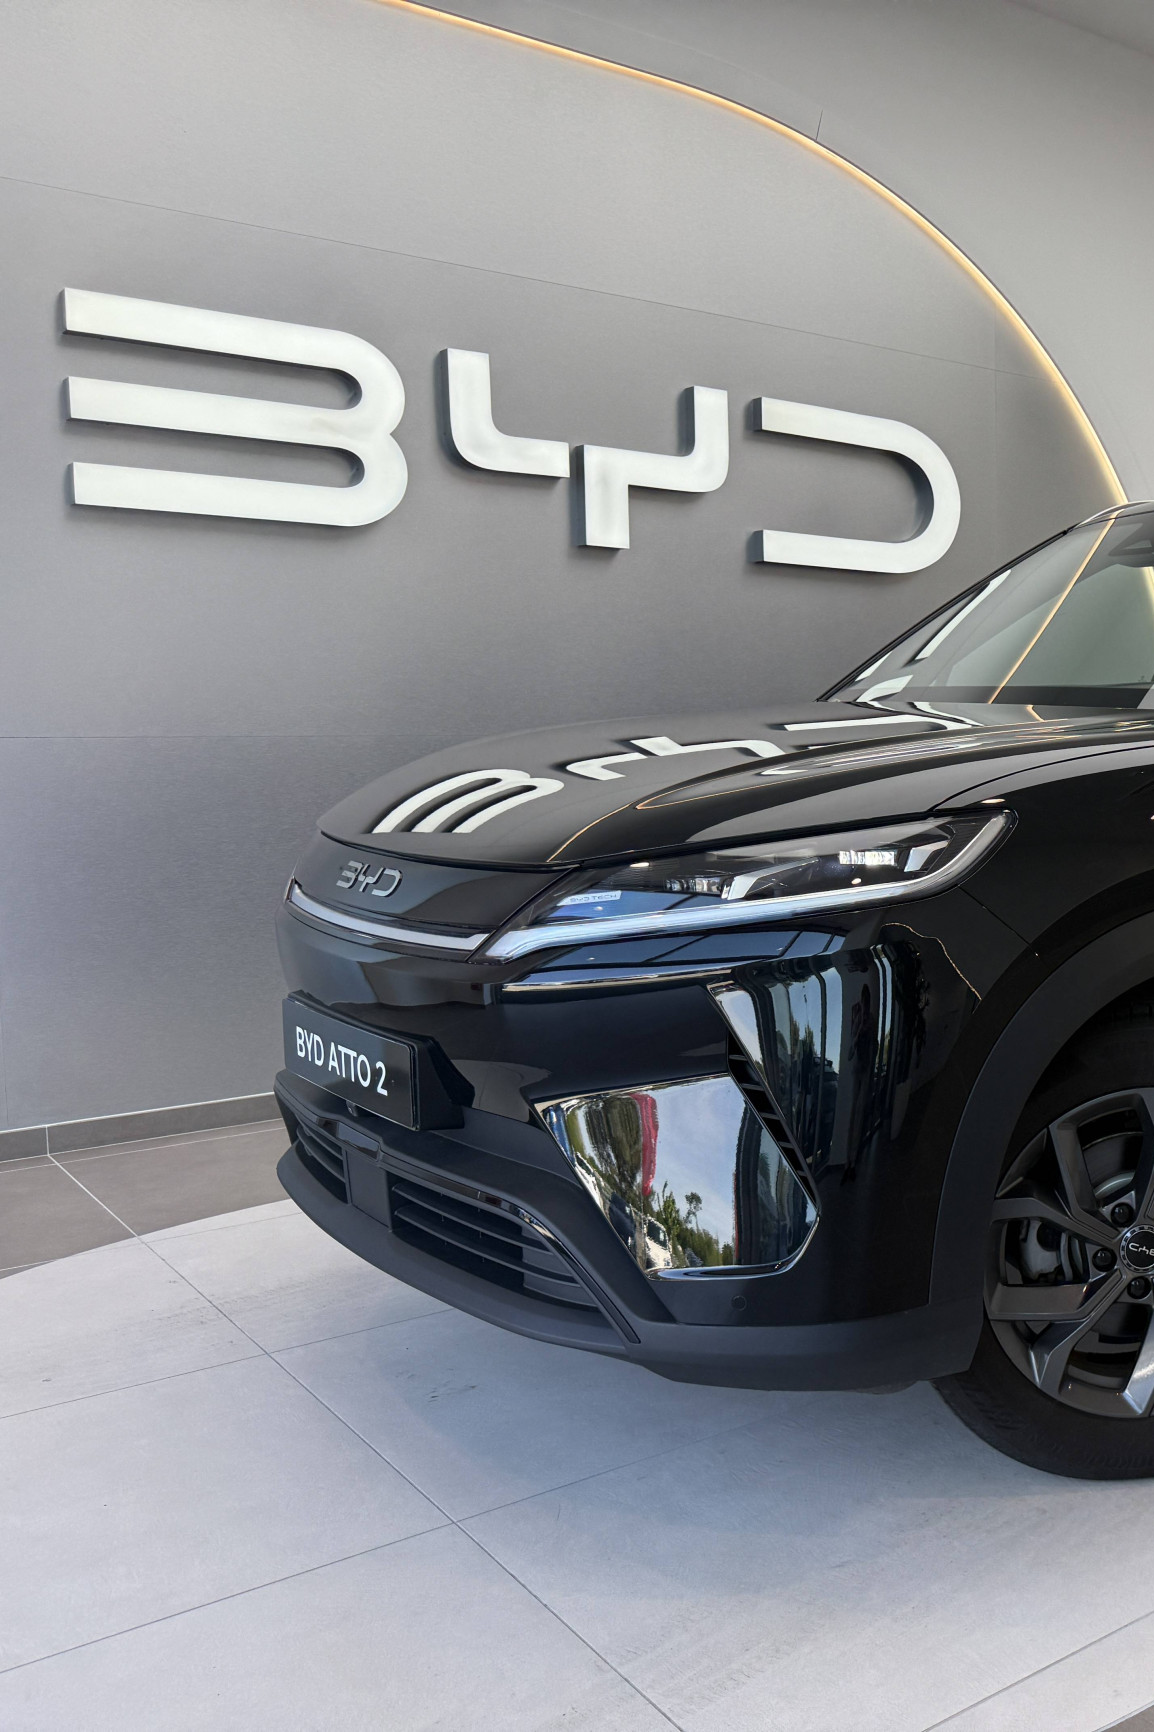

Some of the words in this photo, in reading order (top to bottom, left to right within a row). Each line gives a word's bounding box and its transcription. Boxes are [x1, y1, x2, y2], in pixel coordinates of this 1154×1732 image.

[62, 287, 961, 574] BYD
[336, 860, 403, 897] BYD
[295, 1025, 324, 1067] BYD
[328, 1041, 371, 1088] ATTO
[375, 1060, 388, 1096] 2
